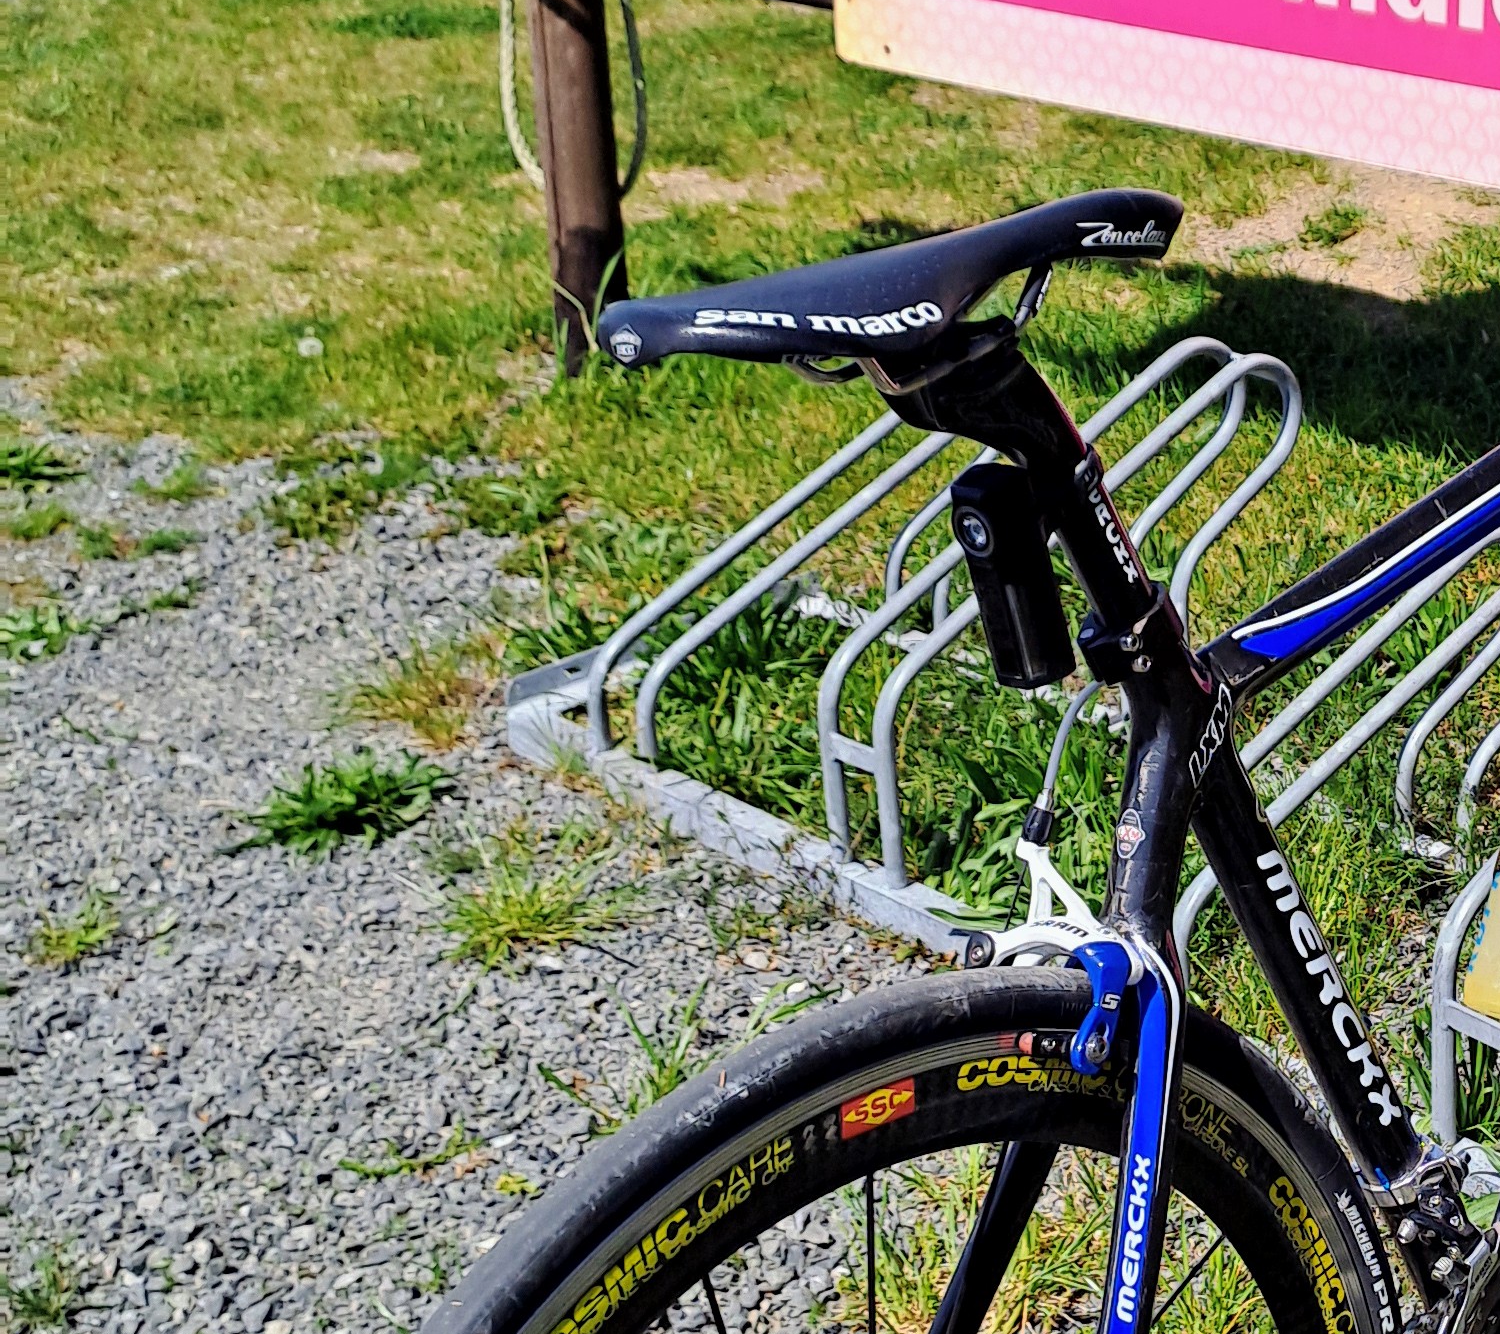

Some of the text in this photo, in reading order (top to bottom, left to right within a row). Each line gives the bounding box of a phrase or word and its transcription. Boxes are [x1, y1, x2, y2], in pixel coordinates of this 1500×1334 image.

[1076, 219, 1167, 247] Zoncolan
[692, 300, 945, 339] san marco
[1030, 918, 1090, 939] SRAM
[1255, 849, 1403, 1128] MERCKX
[1116, 1152, 1153, 1324] MERCKX
[1344, 1204, 1382, 1278] MICHELIN
